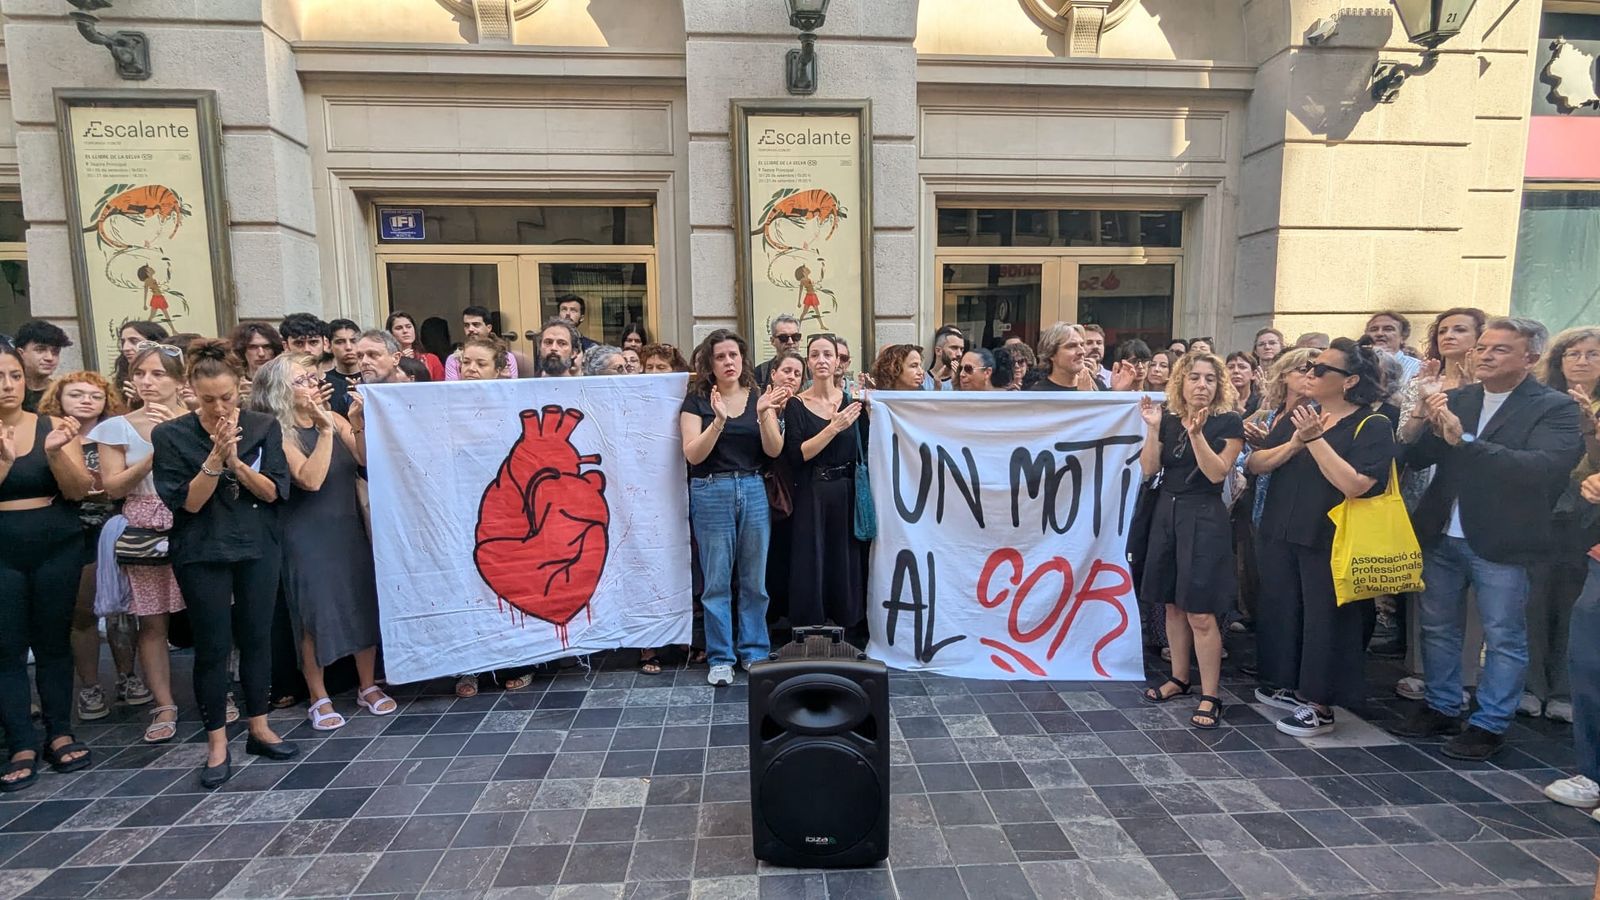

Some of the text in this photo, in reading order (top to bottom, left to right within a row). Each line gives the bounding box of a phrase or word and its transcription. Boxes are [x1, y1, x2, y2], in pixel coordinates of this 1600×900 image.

[1446, 13, 1457, 23] 21
[391, 216, 414, 228] IFI
[892, 433, 985, 529] UN
[1351, 552, 1407, 566] Associació
[1352, 561, 1422, 576] Professionals
[1353, 573, 1412, 585] de la Dansa
[882, 547, 1133, 678] AL COR
